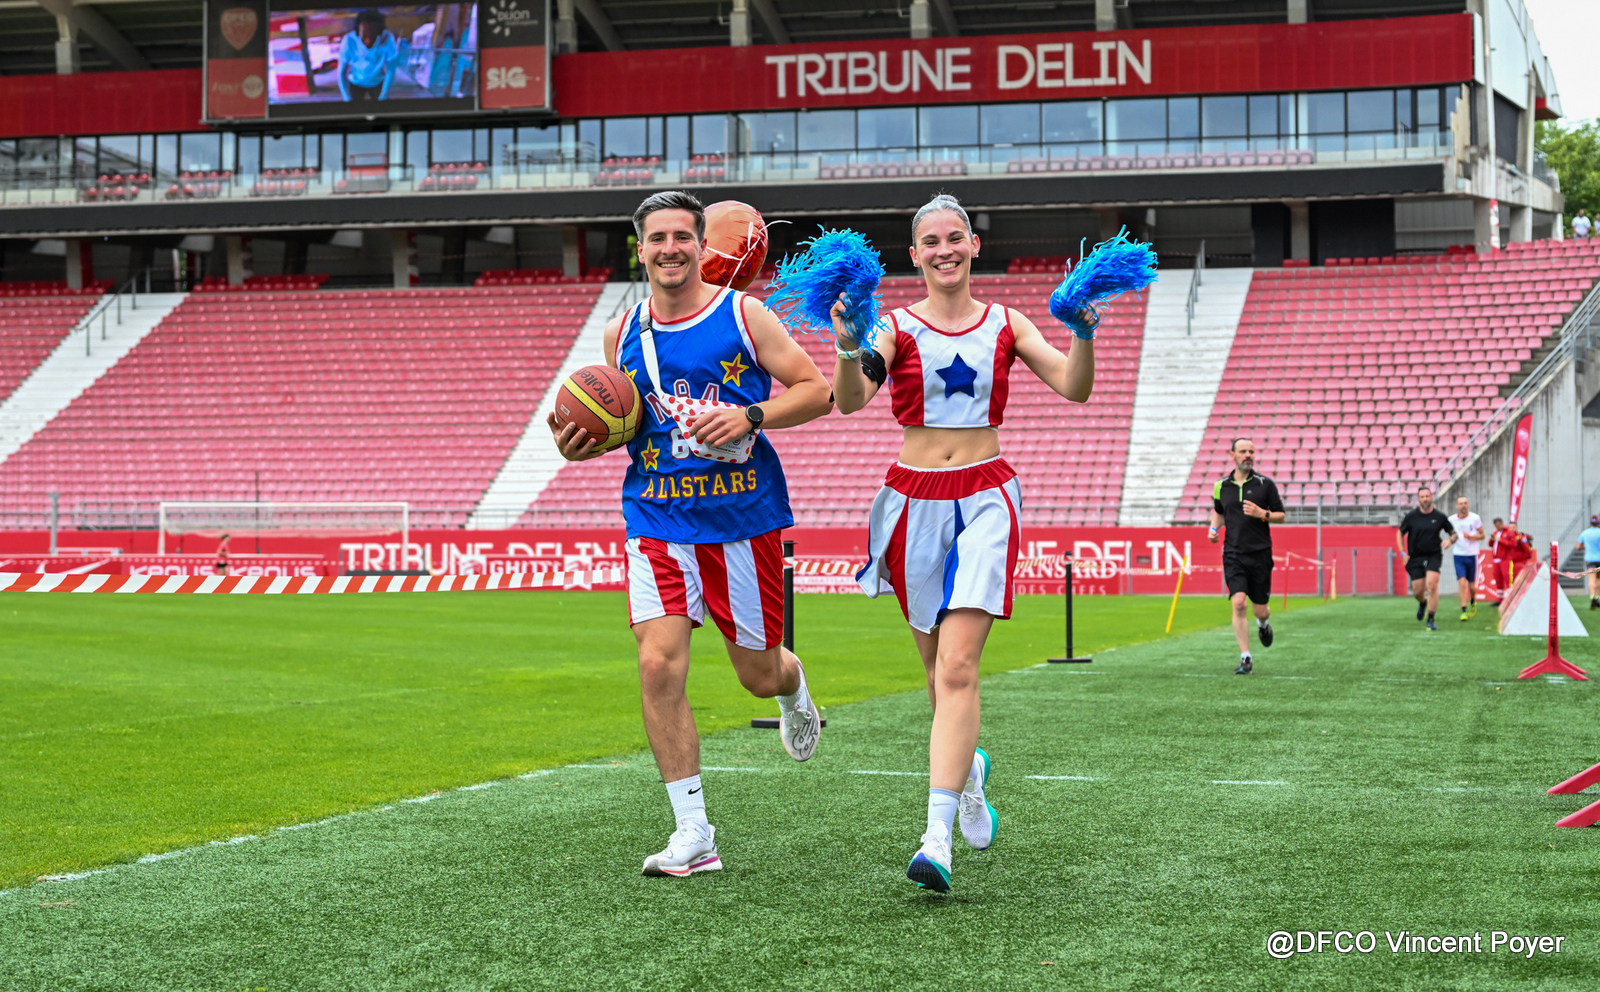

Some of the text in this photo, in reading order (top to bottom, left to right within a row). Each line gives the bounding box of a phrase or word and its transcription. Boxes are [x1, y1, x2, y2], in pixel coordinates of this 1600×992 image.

[486, 66, 527, 90] SIG
[765, 39, 1152, 98] TRIBUNE DELIN
[576, 369, 614, 405] molten
[639, 468, 757, 499] ALLSTARS
[1012, 558, 1118, 579] ANSARD
[1057, 584, 1107, 595] CEFS
